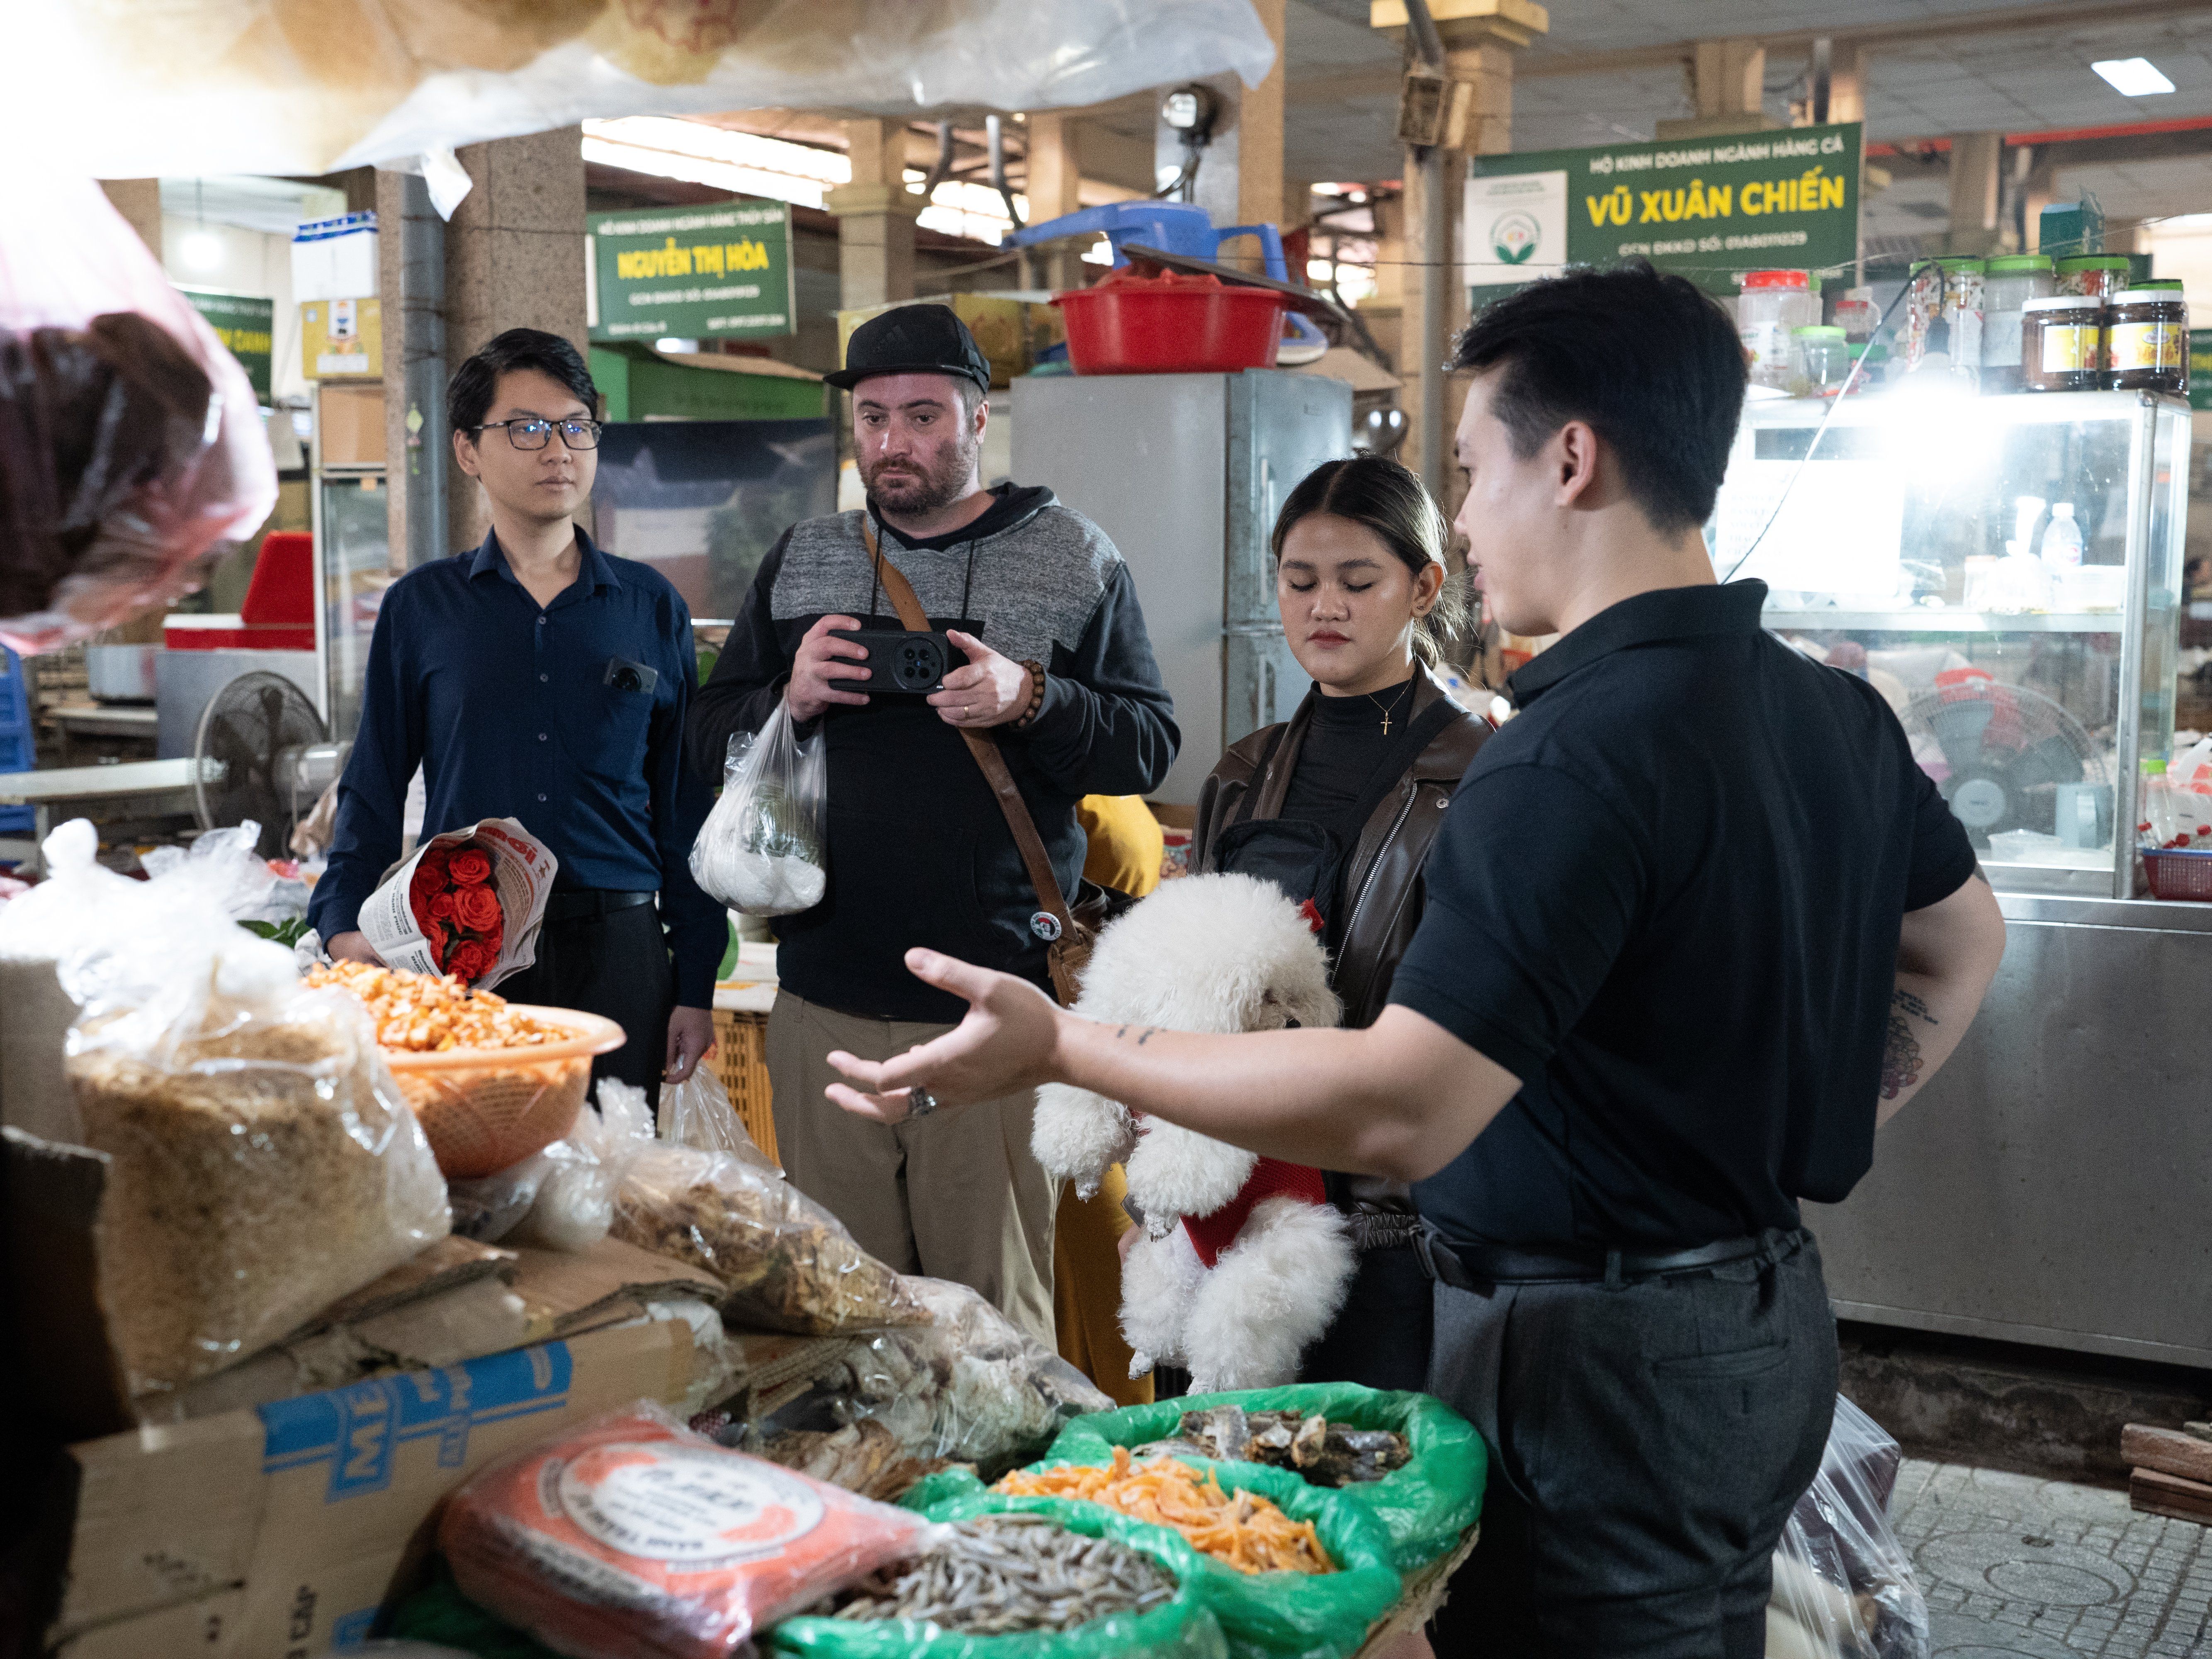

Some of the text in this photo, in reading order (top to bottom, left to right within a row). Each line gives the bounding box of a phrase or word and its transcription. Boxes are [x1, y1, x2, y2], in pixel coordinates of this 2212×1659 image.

[1616, 154, 1654, 171] KINH
[1655, 149, 1711, 169] DOANH
[1713, 143, 1770, 163] NGÀNH
[1772, 137, 1818, 158] HÀNG
[1586, 165, 1845, 227] VŨ XUÂN CHIẾN
[692, 245, 725, 279] THỊ
